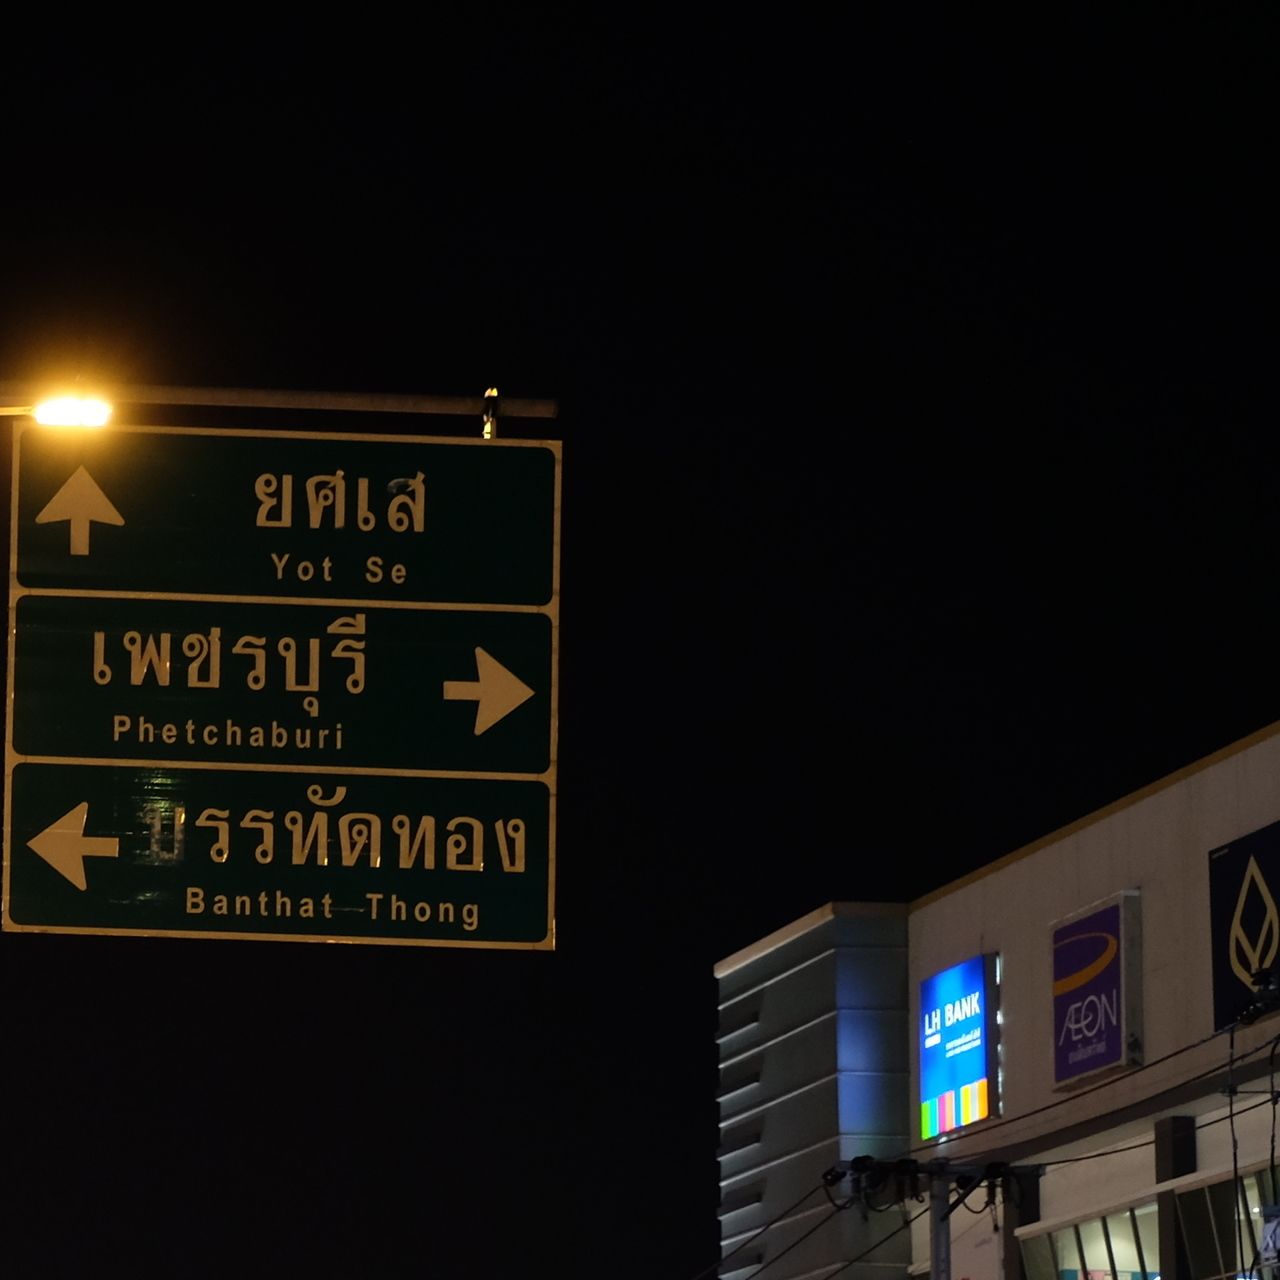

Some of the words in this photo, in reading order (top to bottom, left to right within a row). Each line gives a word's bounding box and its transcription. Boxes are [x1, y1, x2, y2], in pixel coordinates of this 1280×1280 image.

[254, 468, 427, 533] ยศเส
[271, 553, 333, 582] Yot
[365, 555, 407, 585] Se
[92, 613, 367, 717] เพชรบุรี
[113, 715, 343, 750] Phetchaburi
[186, 887, 333, 918] Banthat
[365, 893, 480, 931] Thong
[925, 1008, 941, 1036] LH
[944, 991, 981, 1027] BANK
